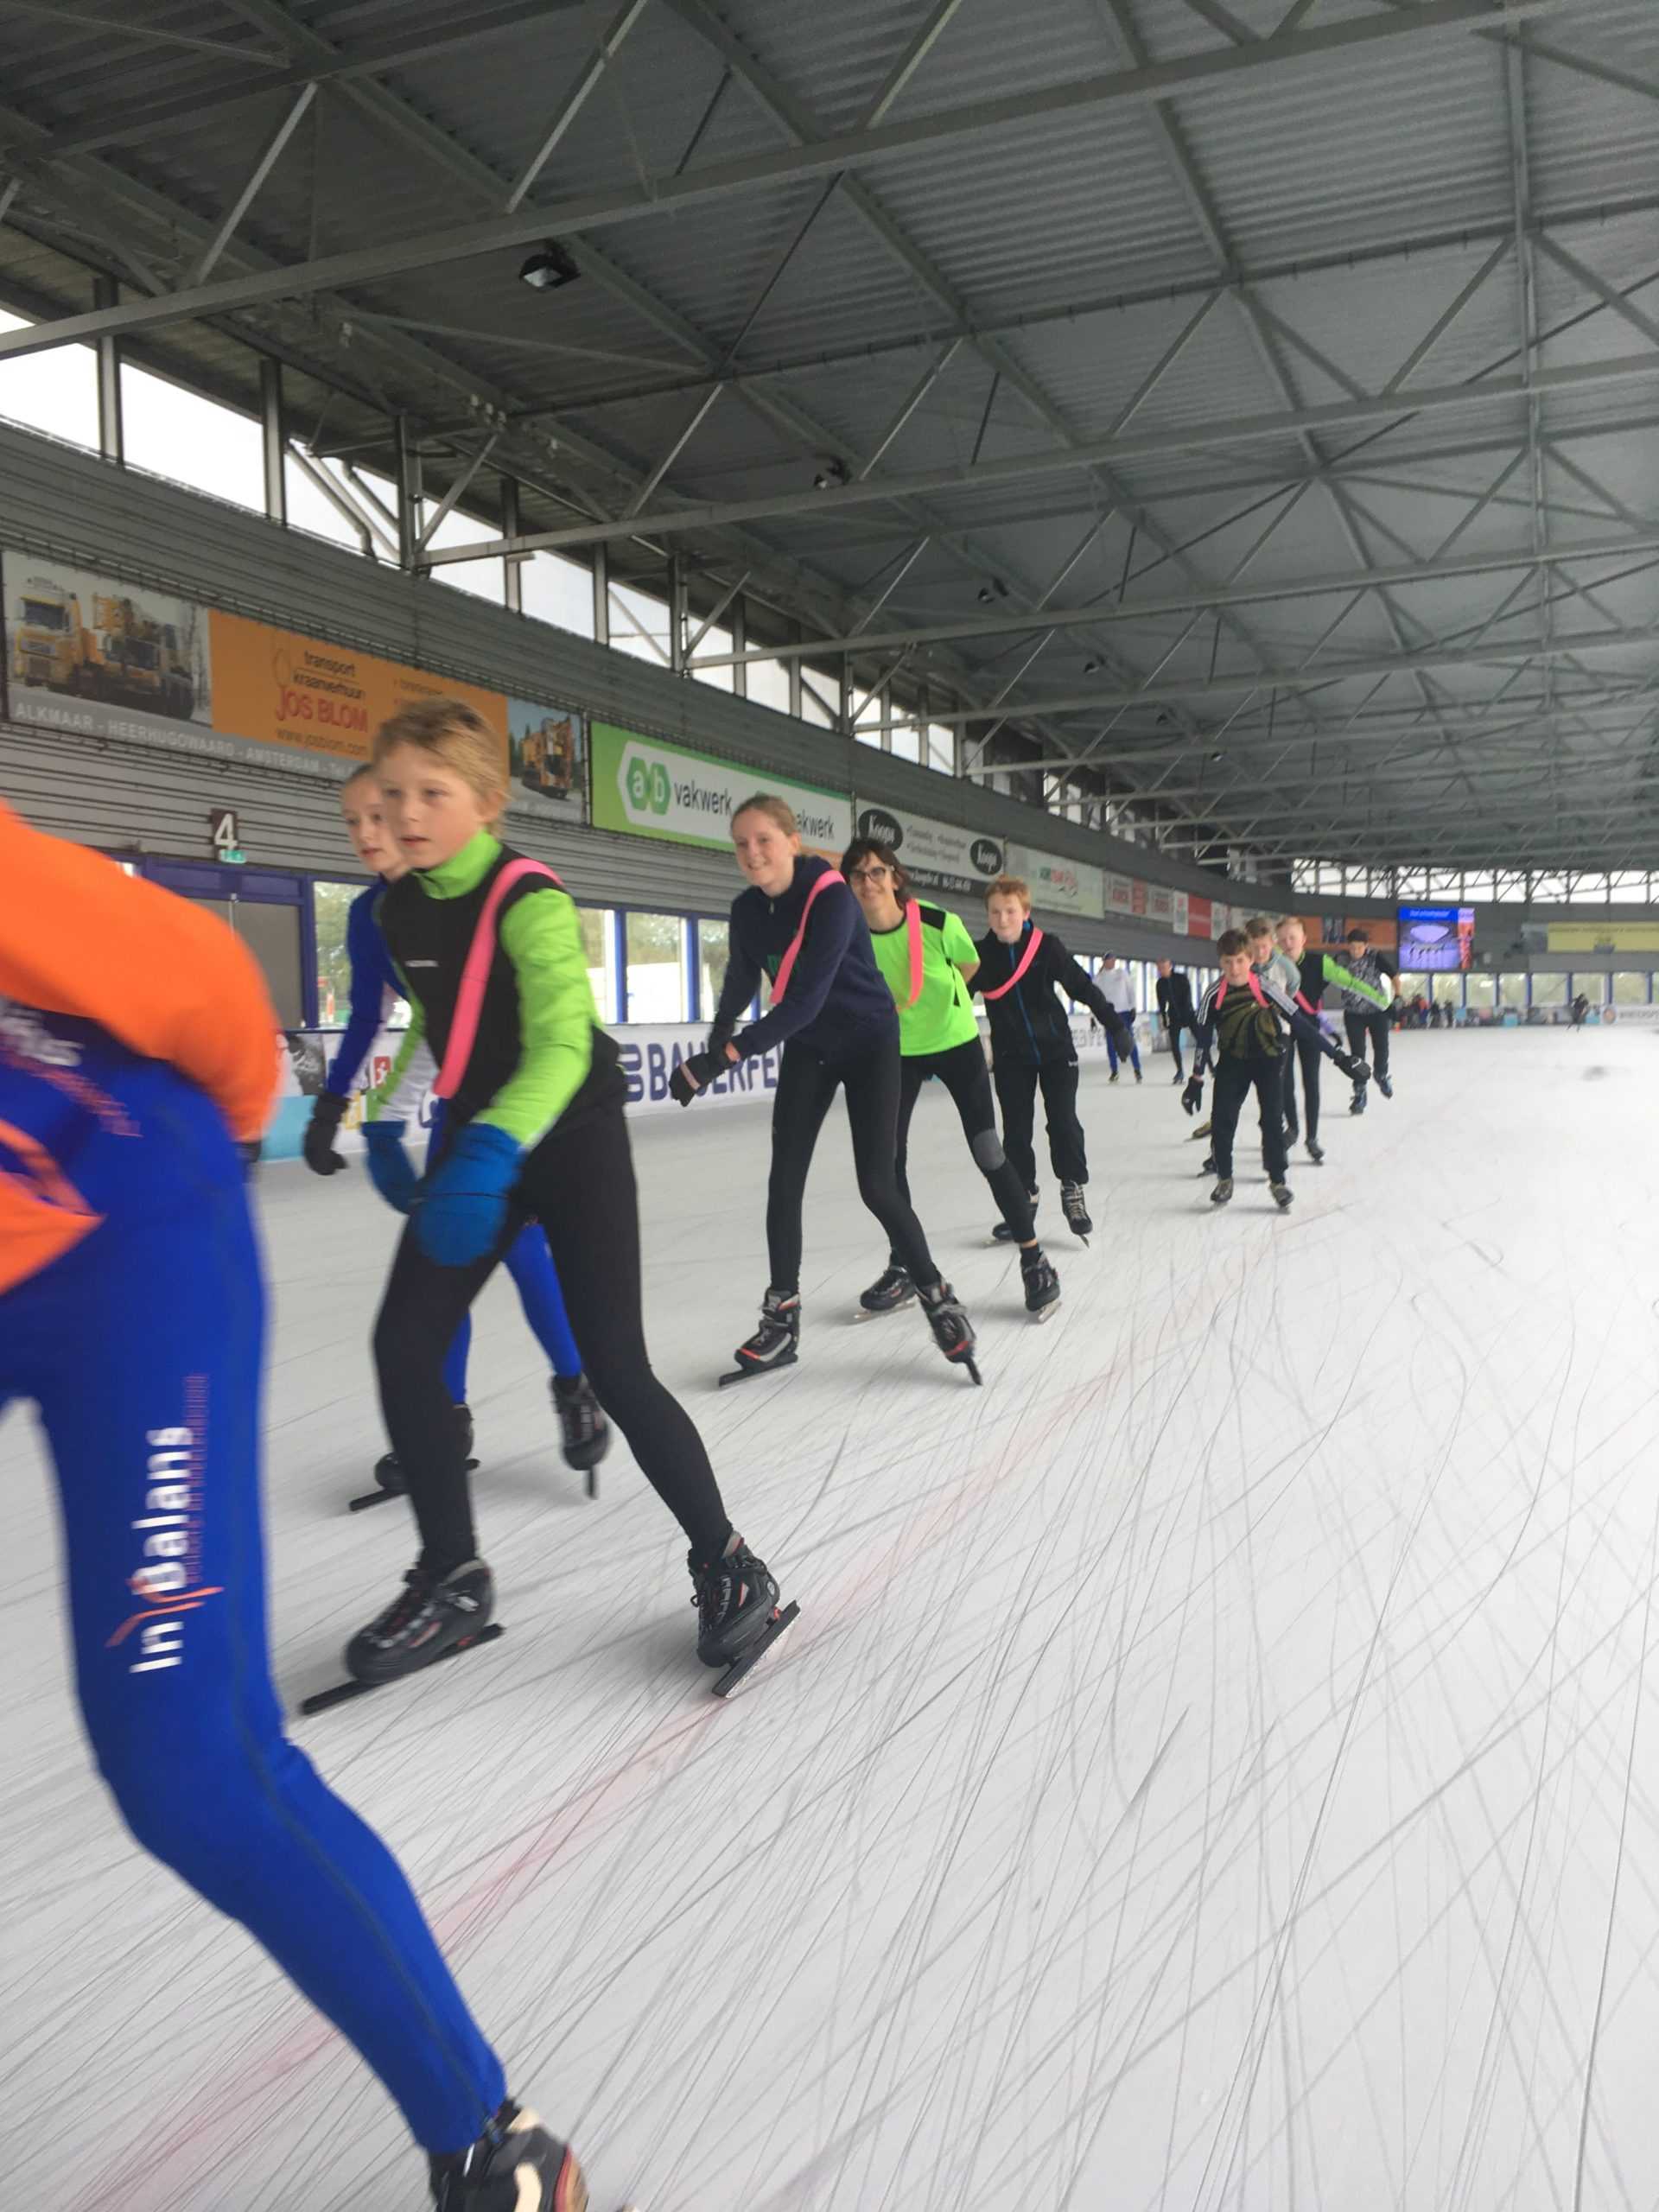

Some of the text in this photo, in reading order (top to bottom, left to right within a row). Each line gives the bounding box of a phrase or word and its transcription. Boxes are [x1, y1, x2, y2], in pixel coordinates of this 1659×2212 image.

[16, 702, 93, 730] ALKMAAR
[108, 719, 234, 757] HEERHUGOWAARD
[276, 691, 367, 733] JOS BLOM
[214, 813, 238, 850] 4
[674, 780, 733, 816] vakwerk
[796, 809, 835, 840] akwerk
